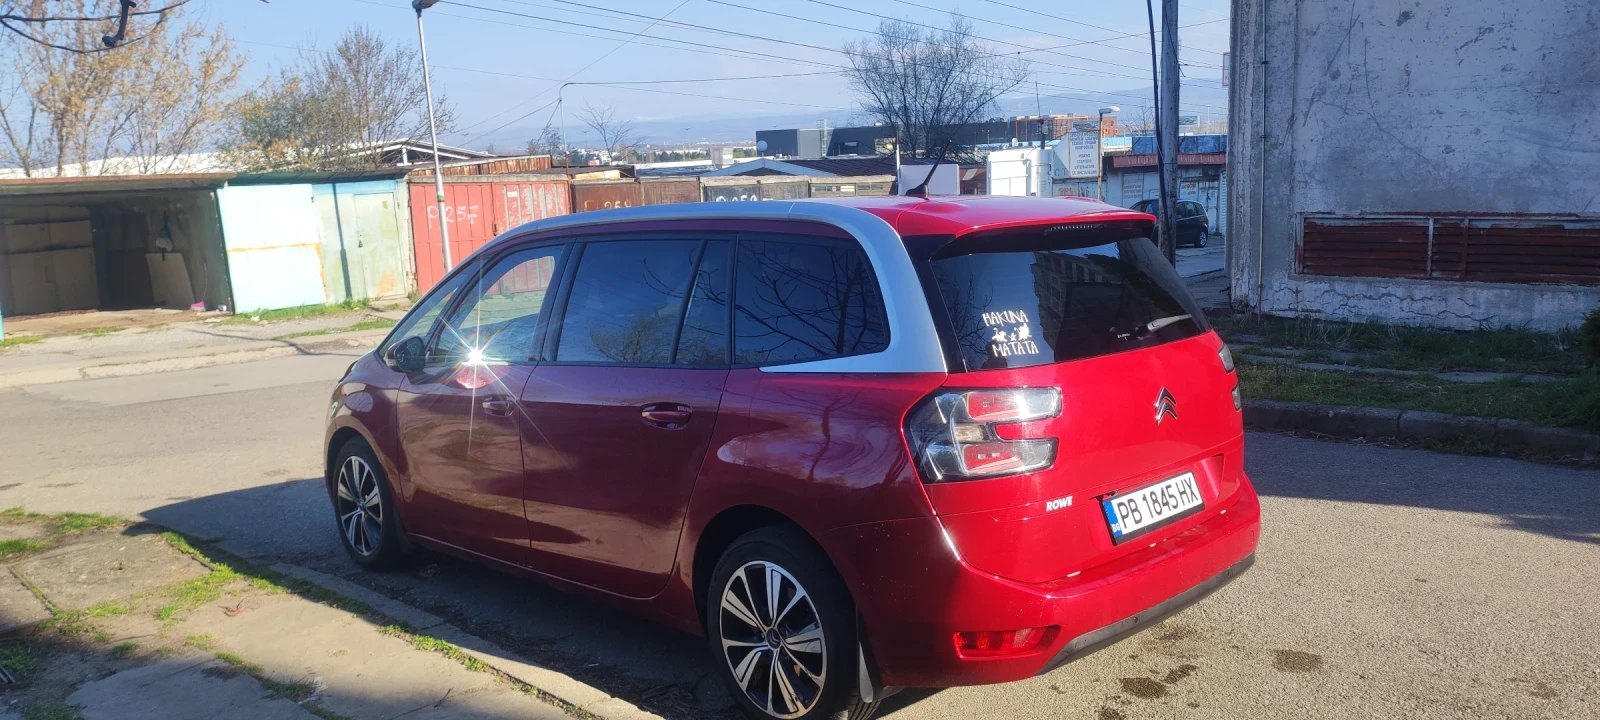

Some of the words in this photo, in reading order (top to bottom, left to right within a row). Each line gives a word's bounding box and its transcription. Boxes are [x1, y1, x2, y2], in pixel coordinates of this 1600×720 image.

[982, 309, 1029, 327] HAKUNA
[992, 340, 1039, 357] MATATA
[1046, 496, 1073, 512] ROWE
